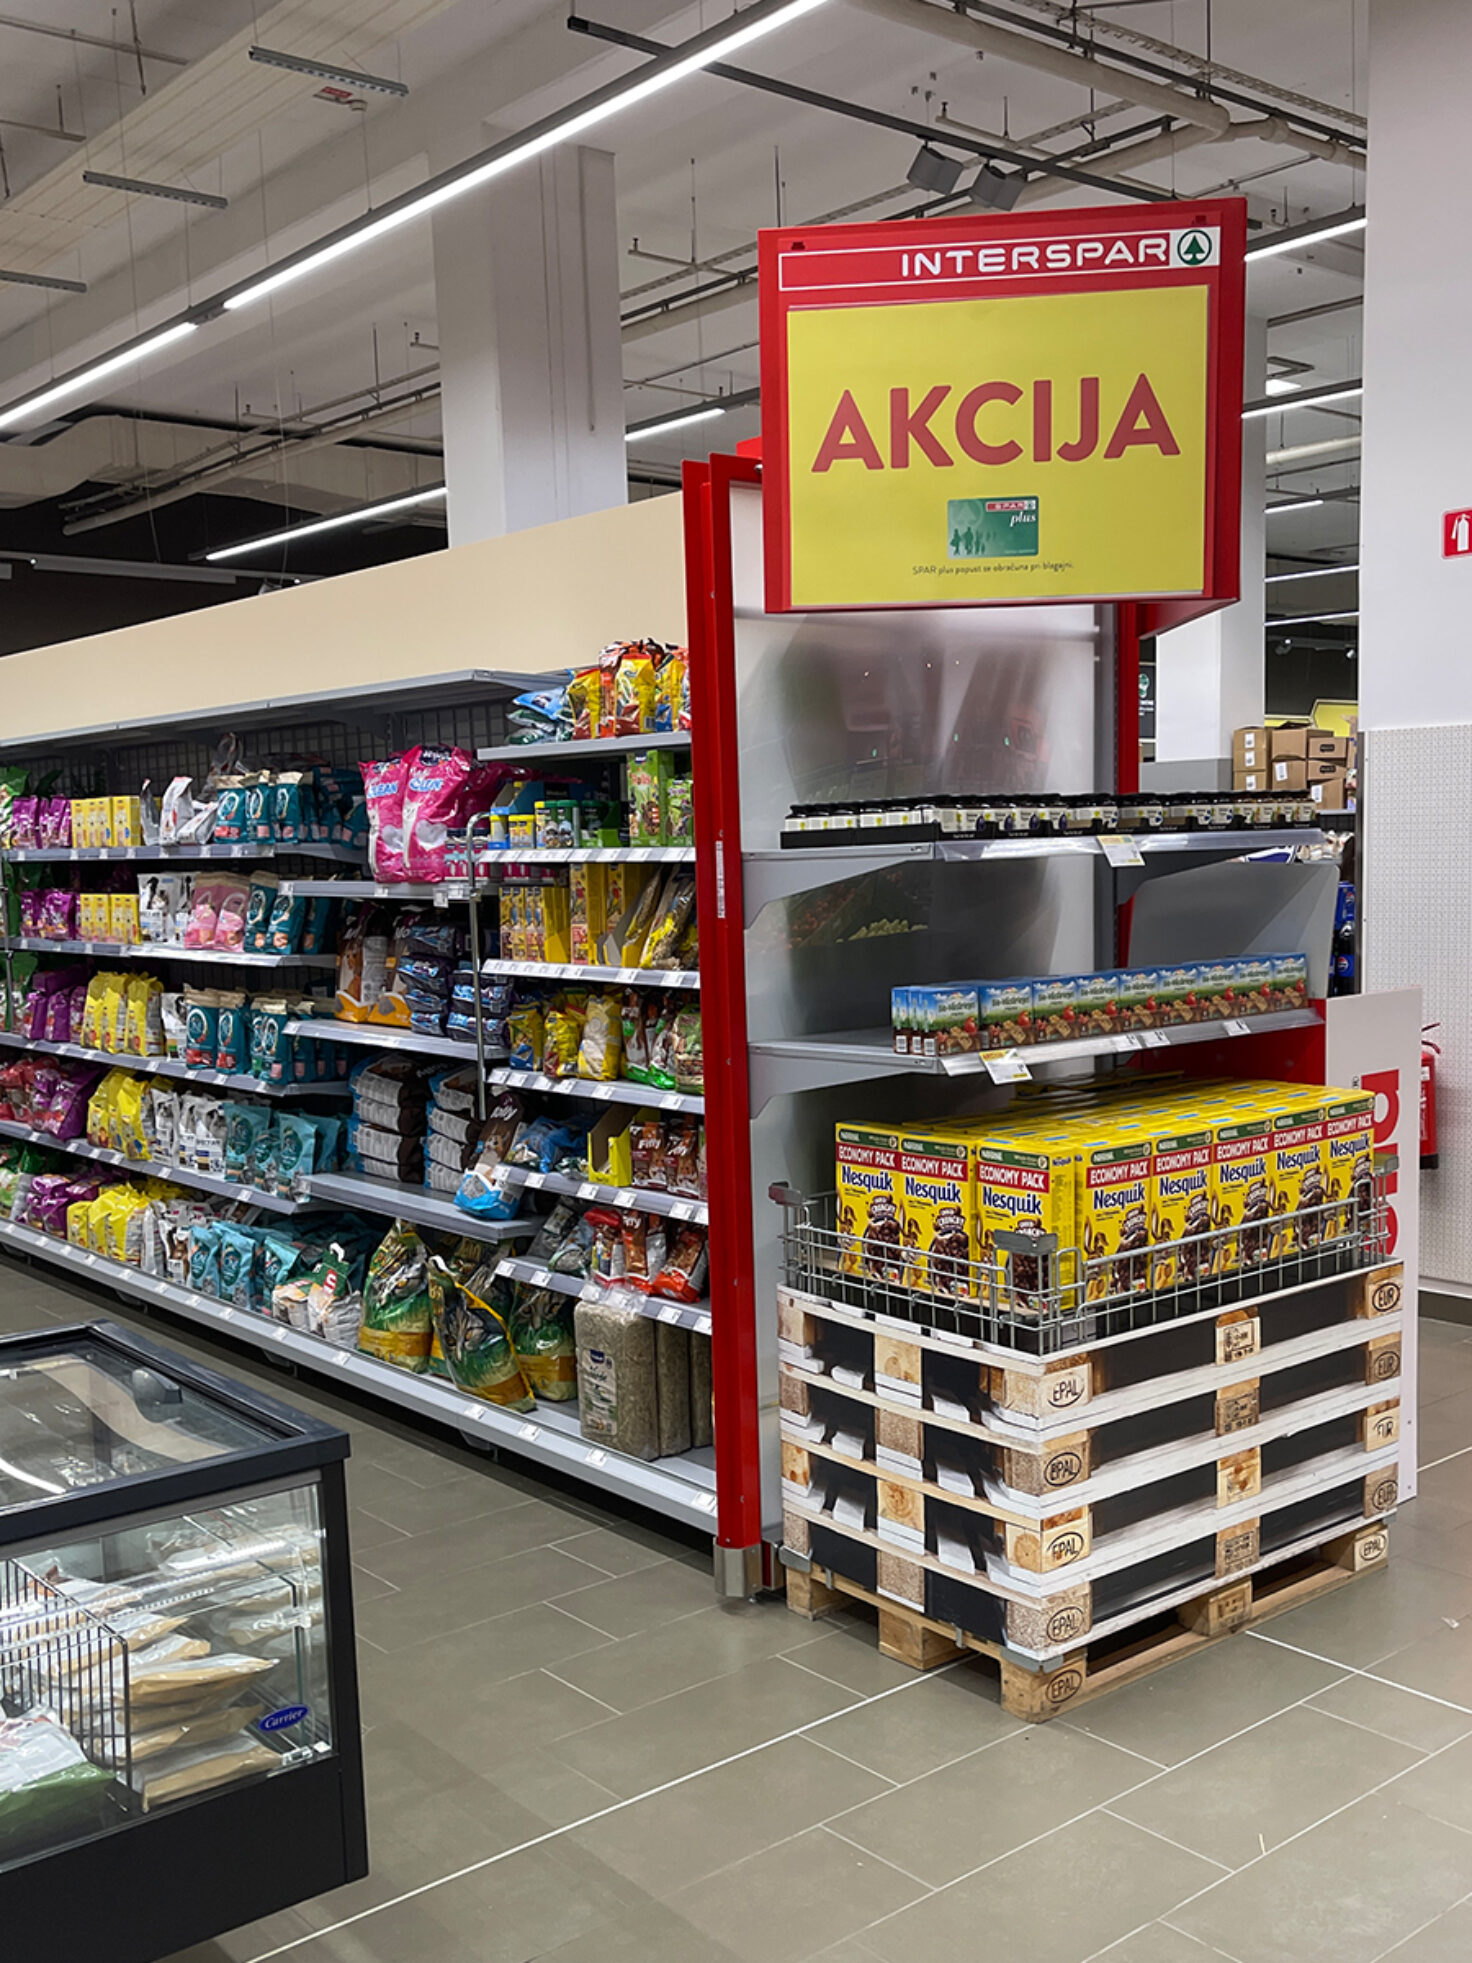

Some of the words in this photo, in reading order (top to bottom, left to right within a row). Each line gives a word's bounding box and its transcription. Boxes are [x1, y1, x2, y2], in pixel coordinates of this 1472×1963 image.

[902, 238, 1168, 277] INTERSPAR
[811, 373, 1181, 472] AKCIJA
[1010, 511, 1036, 527] plus
[912, 565, 937, 576] SPAR
[939, 565, 954, 577] plus
[955, 564, 981, 577] popust
[983, 565, 991, 573] se
[1274, 1129, 1306, 1147] ECONOMY
[1307, 1125, 1322, 1139] PACK
[1327, 1118, 1357, 1136] ECONOMY
[1358, 1114, 1372, 1128] PACK
[838, 1146, 873, 1164] ECONOMY
[875, 1152, 896, 1168] PACK
[1217, 1142, 1251, 1160] ECONOMY
[1252, 1137, 1269, 1152] PACK
[1277, 1144, 1320, 1170] Nesquik
[1330, 1133, 1370, 1158] Nesquik
[902, 1155, 939, 1174] ECONOMY
[942, 1162, 963, 1178] PACK
[1156, 1153, 1193, 1172] ECONOMY
[1193, 1149, 1210, 1165] PACK
[1220, 1157, 1266, 1183] Nesquik
[842, 1165, 893, 1193] Nesquik
[980, 1165, 1019, 1185] ECONOMY
[1021, 1171, 1045, 1190] PACK
[1090, 1166, 1129, 1185] ECONOMY
[1129, 1161, 1149, 1178] PACK
[1159, 1169, 1208, 1197] Nesquik
[905, 1176, 962, 1205] Nesquik
[983, 1185, 1042, 1216] Nesquik
[1094, 1182, 1145, 1210] Nesquik
[1378, 1286, 1395, 1308] EUR
[1053, 1378, 1080, 1402] EPAL
[1050, 1457, 1077, 1481] EPAL
[1052, 1614, 1078, 1637] EPAL
[1051, 1677, 1076, 1699] EPAL
[264, 1708, 304, 1729] Carrier
